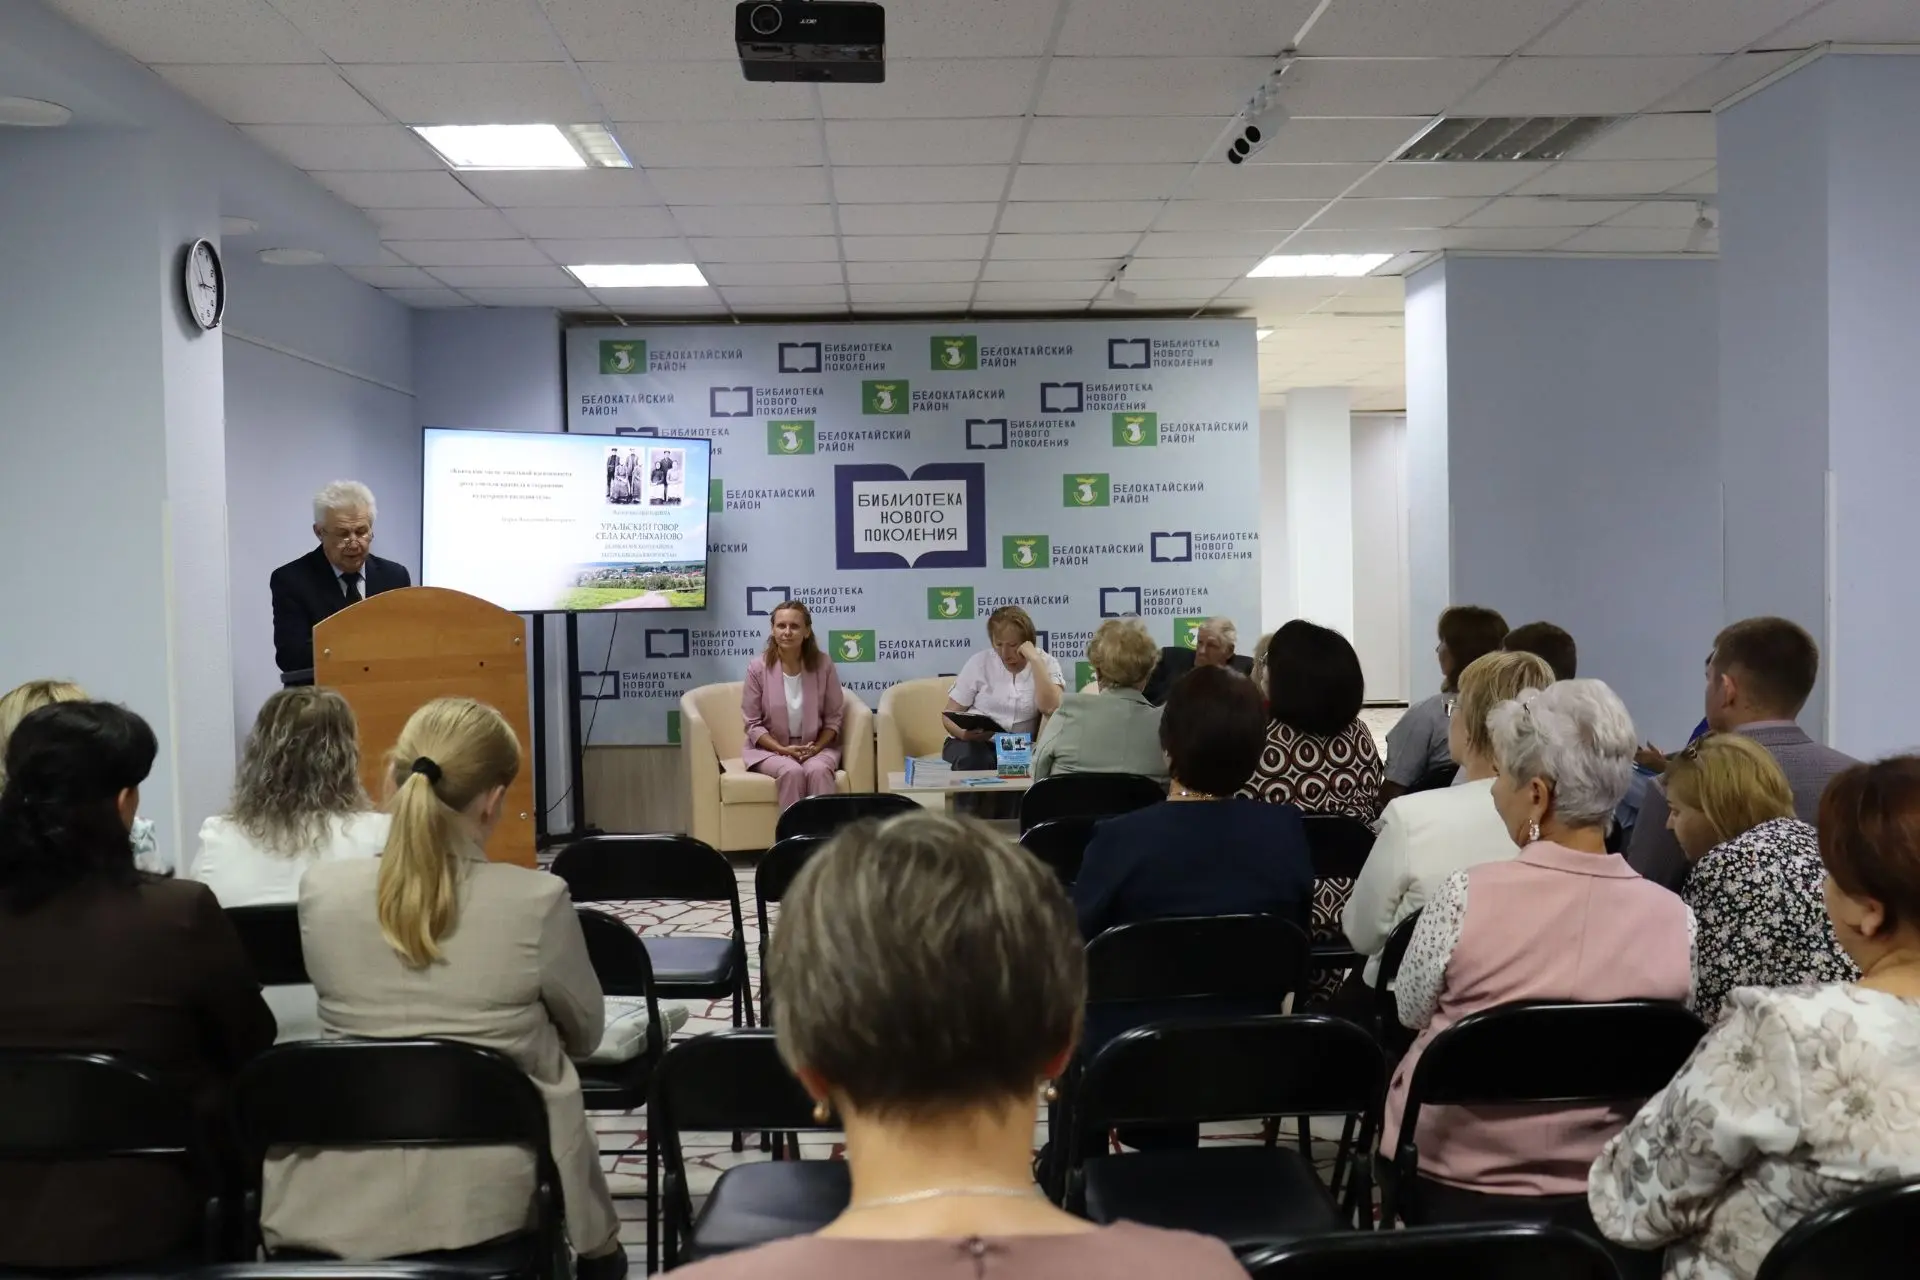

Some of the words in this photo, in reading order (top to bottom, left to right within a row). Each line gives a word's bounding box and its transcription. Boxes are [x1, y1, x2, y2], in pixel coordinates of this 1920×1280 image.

[825, 343, 892, 353] БИБЛИОТЕКА
[1153, 339, 1219, 348] БИБЛИОТЕКА
[650, 349, 742, 360] БЕЛОКАТАЙСКИЙ
[980, 345, 1073, 356] БЕЛОКАТАЙСКИЙ
[1153, 348, 1193, 358] НОВОГО
[825, 352, 865, 362] НОВОГО
[981, 357, 1016, 367] РАЙОН
[650, 361, 686, 372] РАЙОН
[825, 362, 885, 371] ПОКОЛЕНИЯ
[1153, 359, 1213, 367] ПОКОЛЕНИЯ
[756, 388, 823, 396] БИБЛИОТЕКА
[1086, 384, 1152, 392] БИБЛИОТЕКА
[582, 394, 674, 404] БЕЛОКАТАЙСКИЙ
[912, 389, 1004, 400] БЕЛОКАТАЙСКИЙ
[1086, 392, 1126, 401] НОВОГО
[756, 396, 797, 406] НОВОГО
[913, 401, 948, 411] РАЙОН
[1087, 402, 1146, 410] ПОКОЛЕНИЯ
[582, 405, 617, 415] РАЙОН
[757, 407, 816, 416] ПОКОЛЕНИЯ
[1010, 420, 1075, 428] БИБЛИОТЕКА
[1160, 422, 1248, 432] БЕЛОКАТАЙСКИЙ
[662, 428, 729, 437] БИБЛИОТЕКА
[818, 430, 910, 440] БЕЛОКАТАЙСКИЙ
[1010, 429, 1050, 439] НОВОГО
[1161, 433, 1194, 443] РАЙОН
[818, 442, 854, 452] РАЙОН
[1011, 439, 1069, 448] ПОКОЛЕНИЯ
[1113, 482, 1204, 493] БЕЛОКАТАЙСКИЙ
[727, 488, 814, 499] БЕЛОКАТАЙСКИЙ
[1114, 494, 1148, 503] РАЙОН
[858, 493, 962, 506] БИБЛИОТЕКА
[727, 500, 760, 510] РАЙОН
[881, 510, 944, 524] НОВОГО
[654, 523, 679, 532] ГОВОР
[595, 532, 618, 540] СЕЛА
[865, 528, 956, 541] ПОКОЛЕНИЯ
[1195, 532, 1258, 541] БИБЛИОТЕКА
[1053, 544, 1143, 555] БЕЛОКАТАЙСКИЙ
[1195, 542, 1233, 550] НОВОГО
[1053, 556, 1088, 566] РАЙОН
[1195, 552, 1252, 560] ПОКОЛЕНИЯ
[794, 587, 863, 596] БИБЛИОТЕКА
[1144, 588, 1208, 596] БИБЛИОТЕКА
[978, 595, 1068, 607] БЕЛОКАТАЙСКИЙ
[1144, 597, 1182, 606] НОВОГО
[809, 605, 856, 614] КОЛЕНИЯ
[1144, 606, 1201, 615] ПОКОЛЕНИЯ
[692, 630, 761, 638] БИБЛИОТЕКА
[692, 639, 734, 647] НОВОГО
[879, 638, 970, 649] БЕЛОКАТАЙСКИЙ
[693, 648, 754, 656] ПОКОЛЕНИЯ
[879, 650, 914, 659] РАЙОН
[623, 672, 692, 681] БИБЛИОТЕКА
[623, 680, 664, 690] НОВОГО
